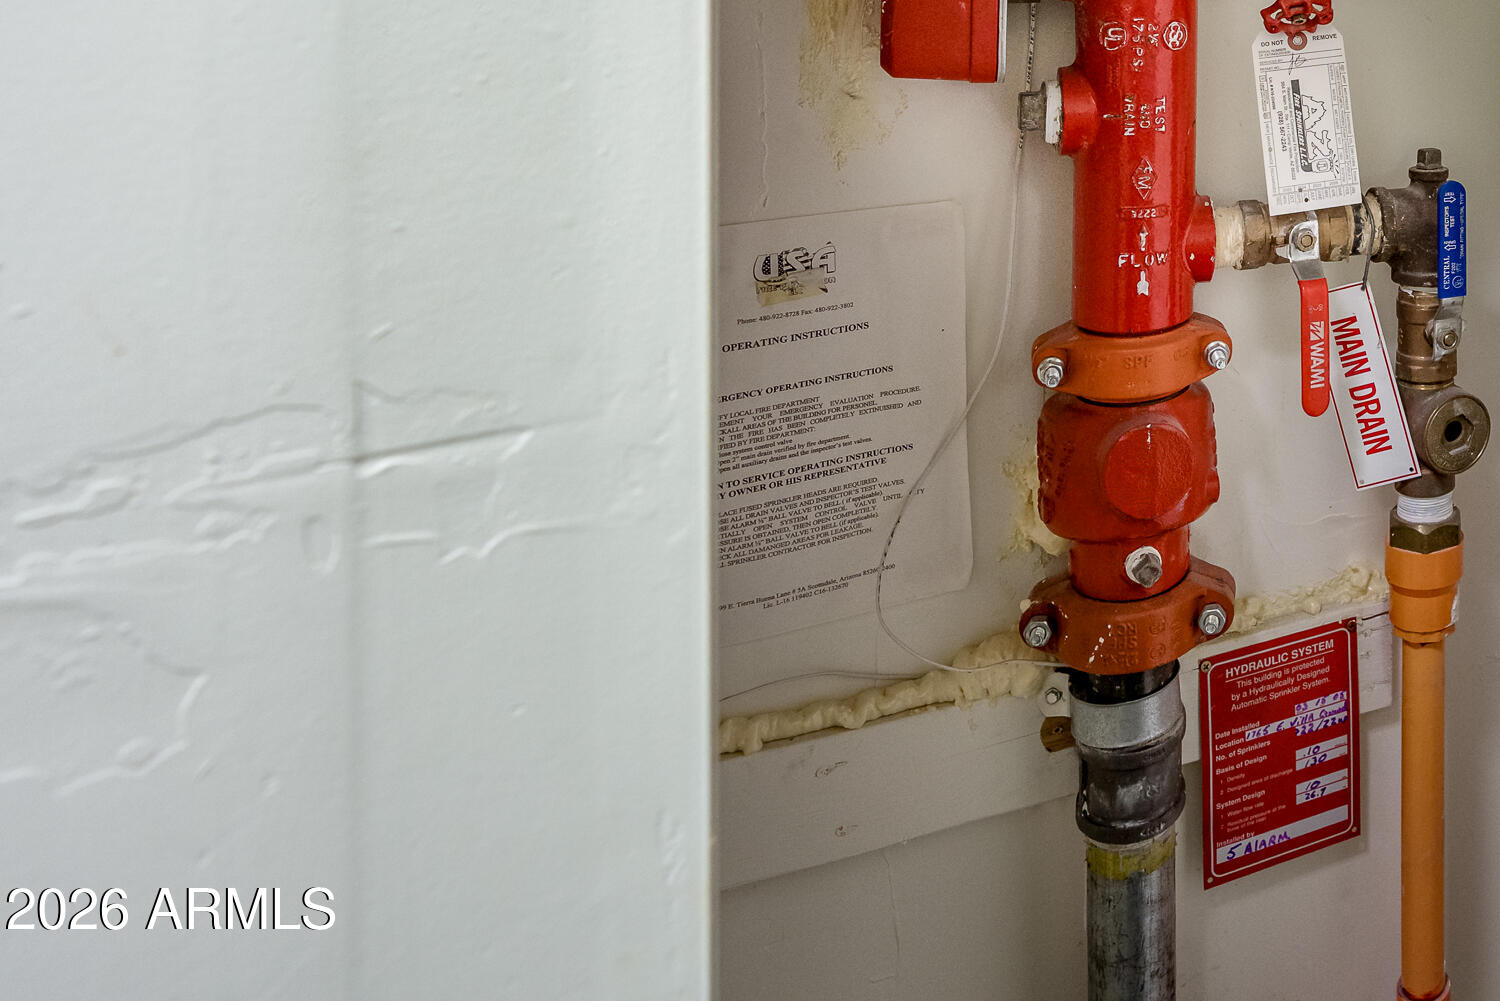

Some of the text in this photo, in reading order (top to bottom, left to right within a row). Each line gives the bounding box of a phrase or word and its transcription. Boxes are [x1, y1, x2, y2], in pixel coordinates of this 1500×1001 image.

[1312, 33, 1337, 41] REMOVE
[1155, 96, 1167, 133] TEST
[1118, 253, 1169, 268] FLOW
[721, 321, 869, 353] OPERATING INSTRUCTIONS
[1309, 341, 1325, 389] WAMI
[765, 377, 822, 394] OPERATING
[824, 364, 894, 383] INSTRUCTIONS
[1330, 315, 1393, 456] MAIN DRAIN
[730, 409, 753, 418] LOCAL
[726, 442, 913, 487] TO SERVICE OPERATING INSTRUCTIONS
[728, 457, 886, 497] OWNER OR HIS REPRESENTATIVE
[1225, 639, 1333, 678] HYDRAULIC SYSTEM
[1231, 692, 1240, 701] by
[1249, 676, 1294, 696] Hydraulically
[1296, 666, 1329, 682] Designed
[1236, 678, 1251, 688] This
[1254, 670, 1282, 683] building
[1292, 658, 1324, 673] protected
[1231, 695, 1267, 711] Automatic
[1269, 685, 1300, 700] Sprinkler
[1215, 721, 1259, 739] Date Installed
[1215, 737, 1244, 750] Location
[1236, 739, 1270, 755] Sprinklers
[1215, 765, 1234, 776] Basis
[1244, 755, 1267, 766] Design
[1216, 789, 1265, 810] System Design
[1216, 834, 1244, 848] Installed
[1226, 844, 1242, 860] 5
